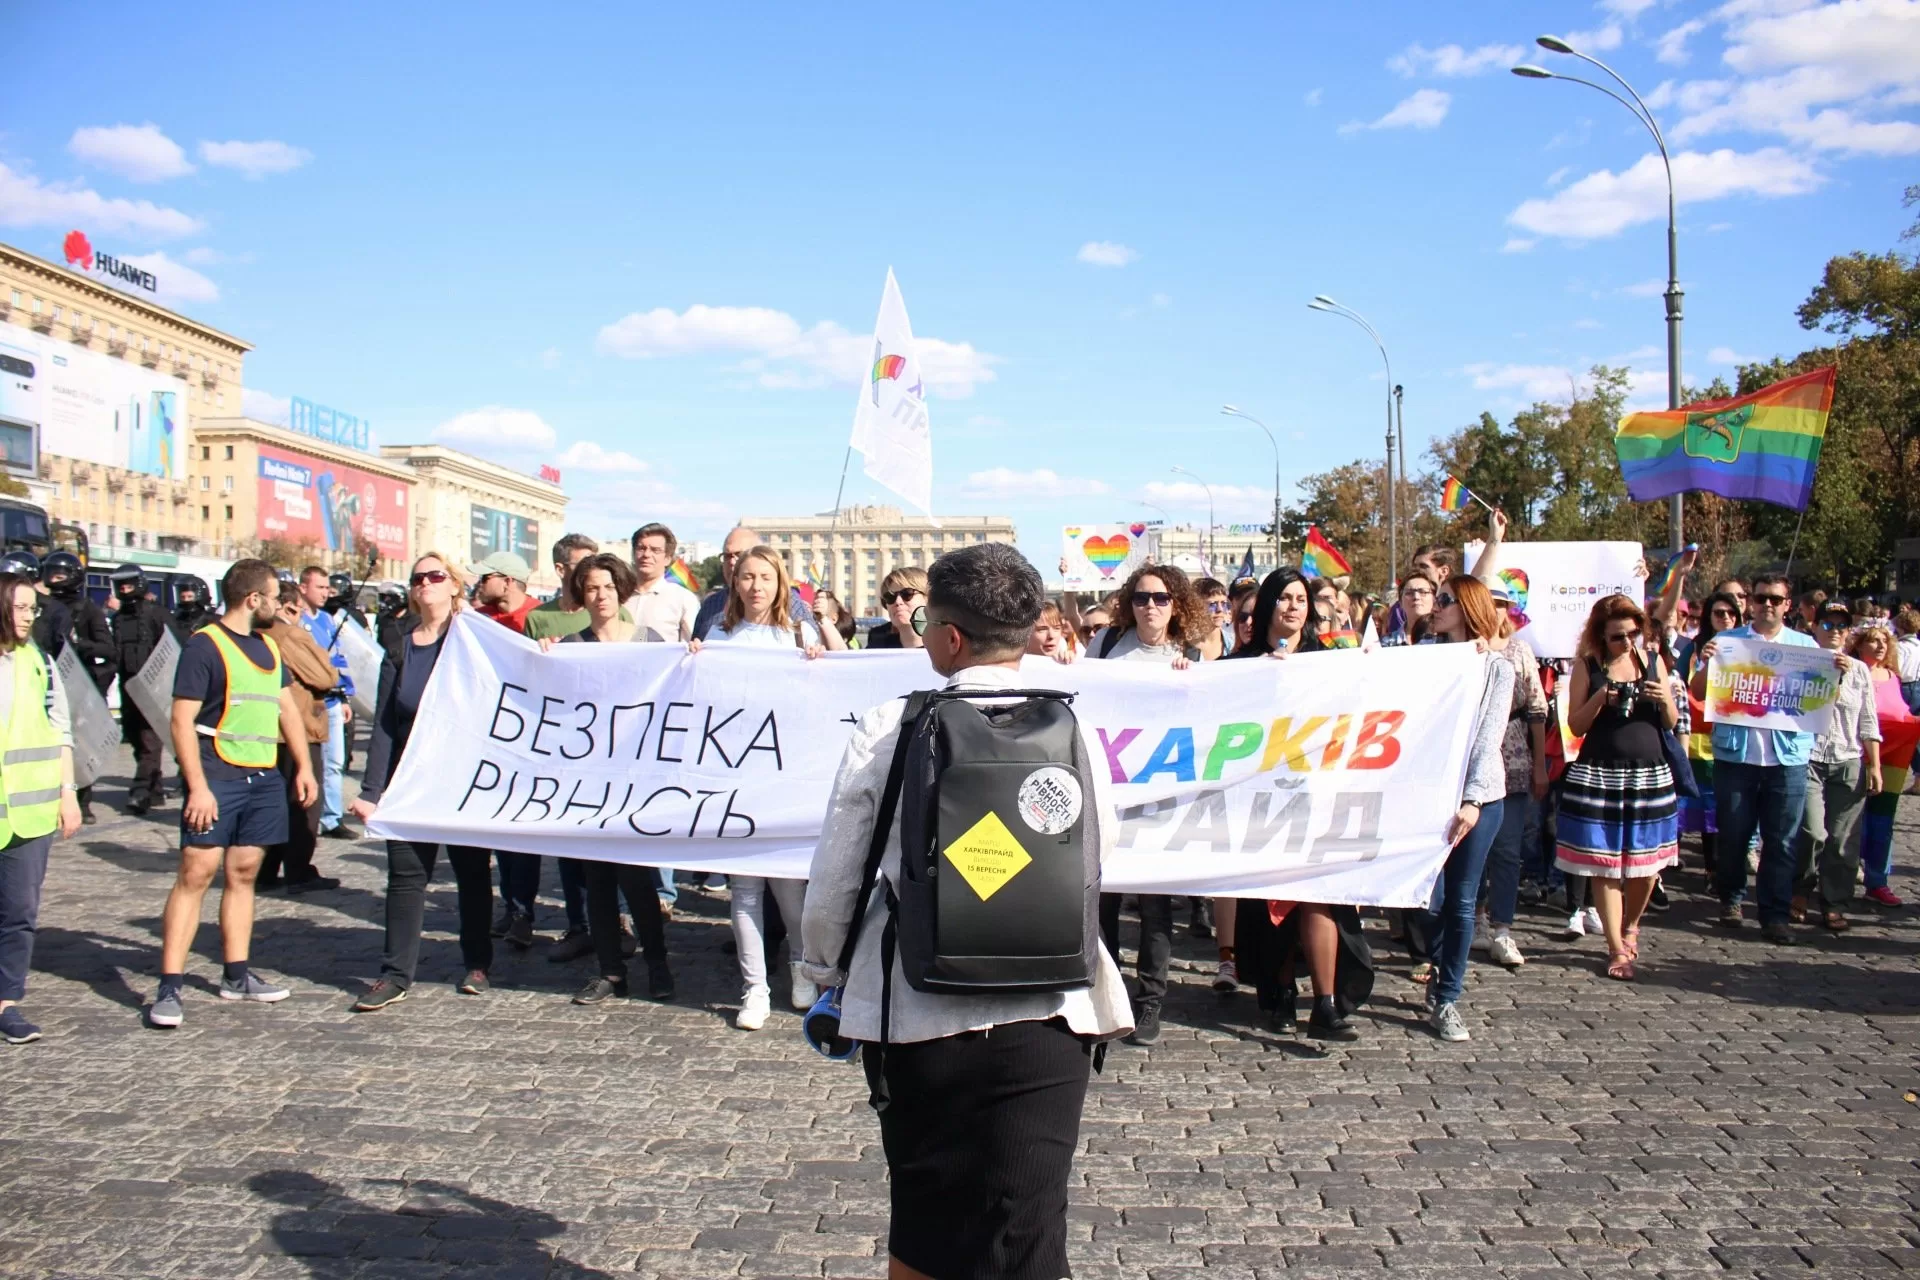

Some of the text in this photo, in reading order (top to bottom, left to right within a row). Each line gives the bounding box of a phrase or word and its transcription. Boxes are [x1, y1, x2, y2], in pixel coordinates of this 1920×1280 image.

[96, 251, 157, 292] HUAWEI
[291, 395, 369, 450] MEIZU
[1551, 582, 1632, 597] KappaPride
[1712, 671, 1831, 700] ВІЛЬНІ ТА РІВНІ
[1732, 690, 1804, 709] FREE & EQUAL
[489, 682, 783, 771] БЕЗПЕКА
[1095, 710, 1407, 784] ХАРКІВ
[457, 759, 757, 839] РІВНІСТЬ
[1030, 780, 1072, 821] РІВНОСТІ
[1043, 777, 1072, 807] МАРШ
[1115, 776, 1384, 863] РАЙД
[963, 846, 1014, 858] ХАРКІВПРАЙД
[976, 865, 1007, 874] ВЕРЕСНЯ
